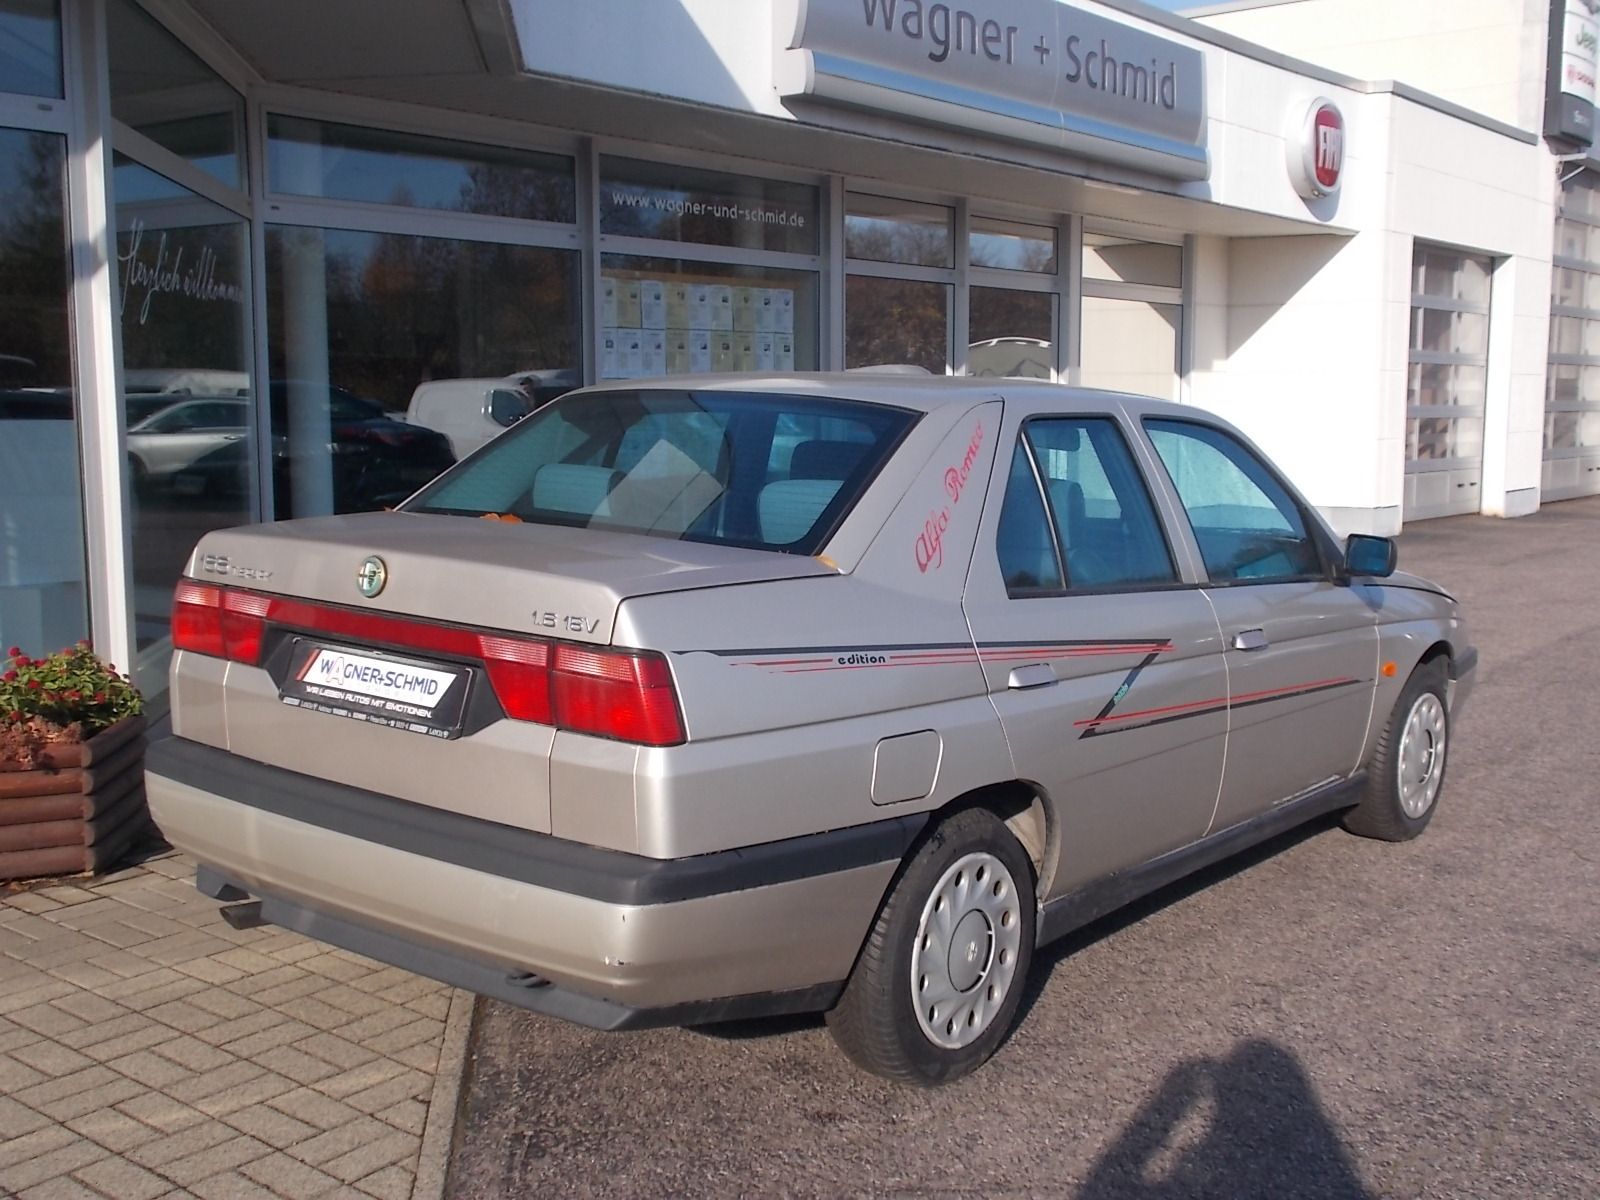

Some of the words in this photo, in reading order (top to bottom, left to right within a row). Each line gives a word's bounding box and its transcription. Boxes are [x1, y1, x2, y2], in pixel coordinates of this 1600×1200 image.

[1032, 35, 1051, 65] +
[1065, 34, 1177, 110] Schmid
[611, 191, 805, 228] www.wagner-und-schmid.de
[914, 505, 952, 574] Alfa
[944, 418, 985, 504] Romeo
[837, 653, 886, 666] edition
[345, 693, 370, 705] AUTOS
